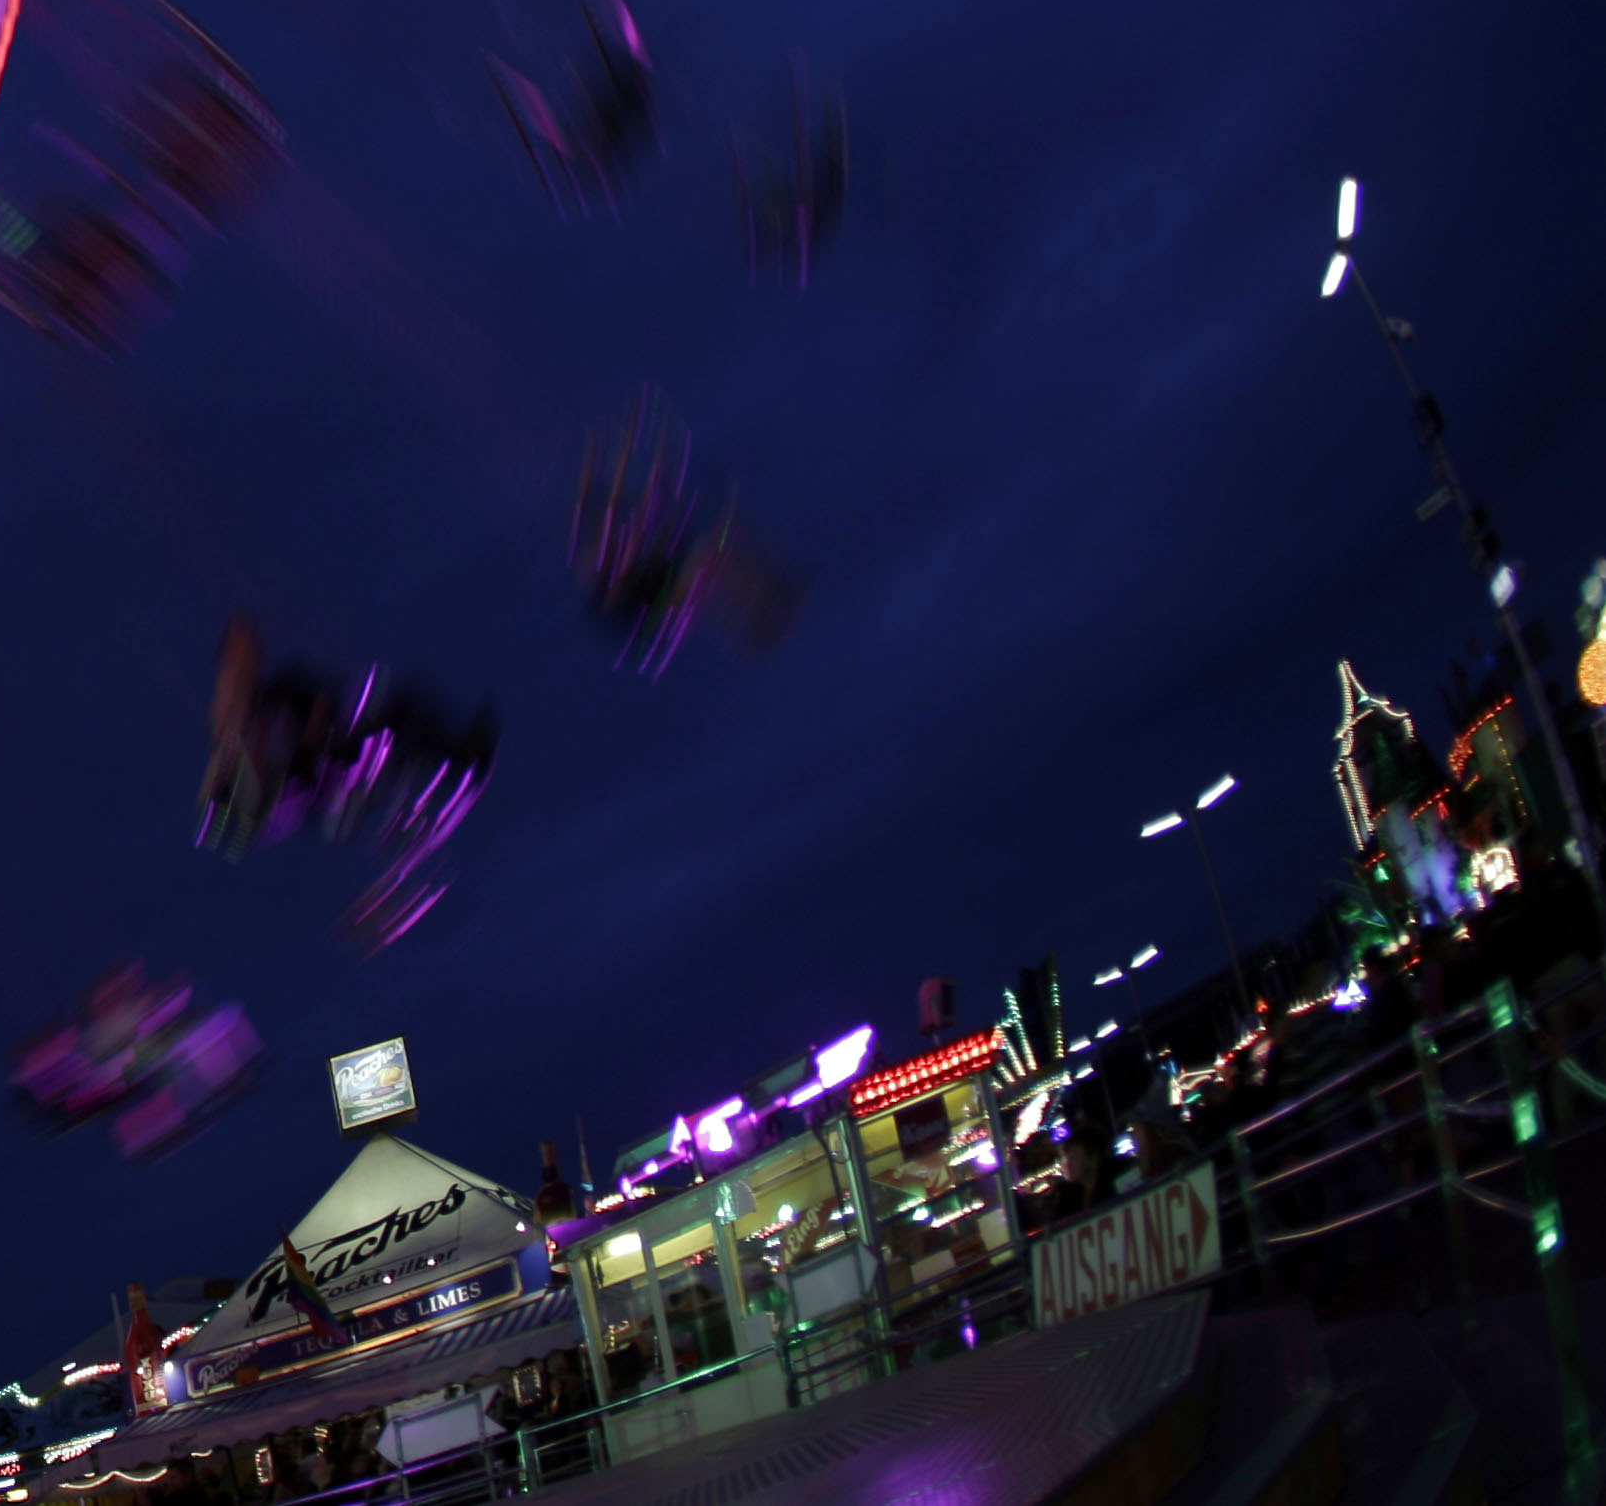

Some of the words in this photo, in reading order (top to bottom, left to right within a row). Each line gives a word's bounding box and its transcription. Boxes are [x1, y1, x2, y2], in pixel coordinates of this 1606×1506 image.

[337, 1040, 404, 1098] Peaches
[1038, 1183, 1189, 1328] AUSGANG
[394, 1308, 411, 1326] &
[416, 1279, 483, 1318] LIMES
